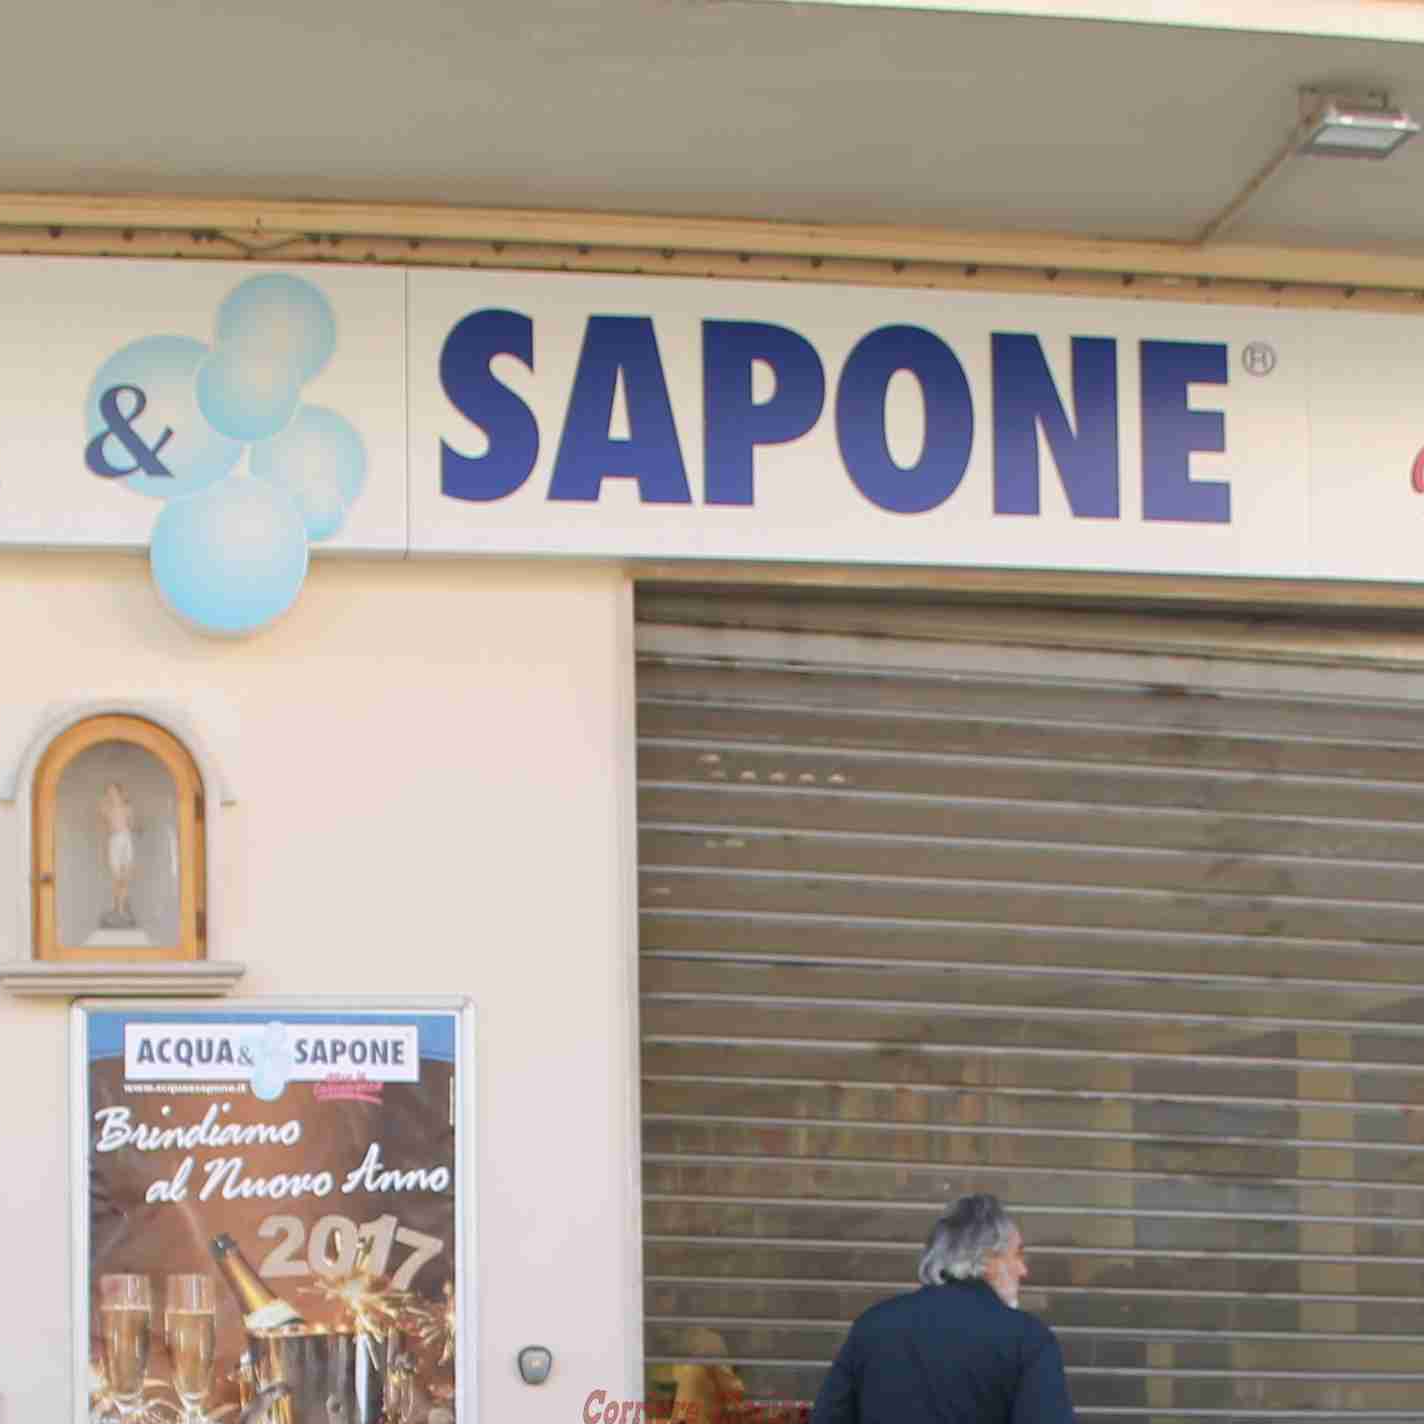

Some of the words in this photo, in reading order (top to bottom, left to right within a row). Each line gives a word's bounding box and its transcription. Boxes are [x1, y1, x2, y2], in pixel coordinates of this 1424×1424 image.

[83, 383, 174, 480] &
[438, 307, 1233, 525] SAPONE
[137, 1037, 234, 1067] ACQUA
[236, 1046, 256, 1067] &
[293, 1037, 405, 1065] SAPONE
[95, 1102, 302, 1151] Brindiamo
[145, 1156, 197, 1203] al
[199, 1157, 333, 1200] Nuovo
[341, 1142, 451, 1193] Anno
[257, 1213, 444, 1291] 2017
